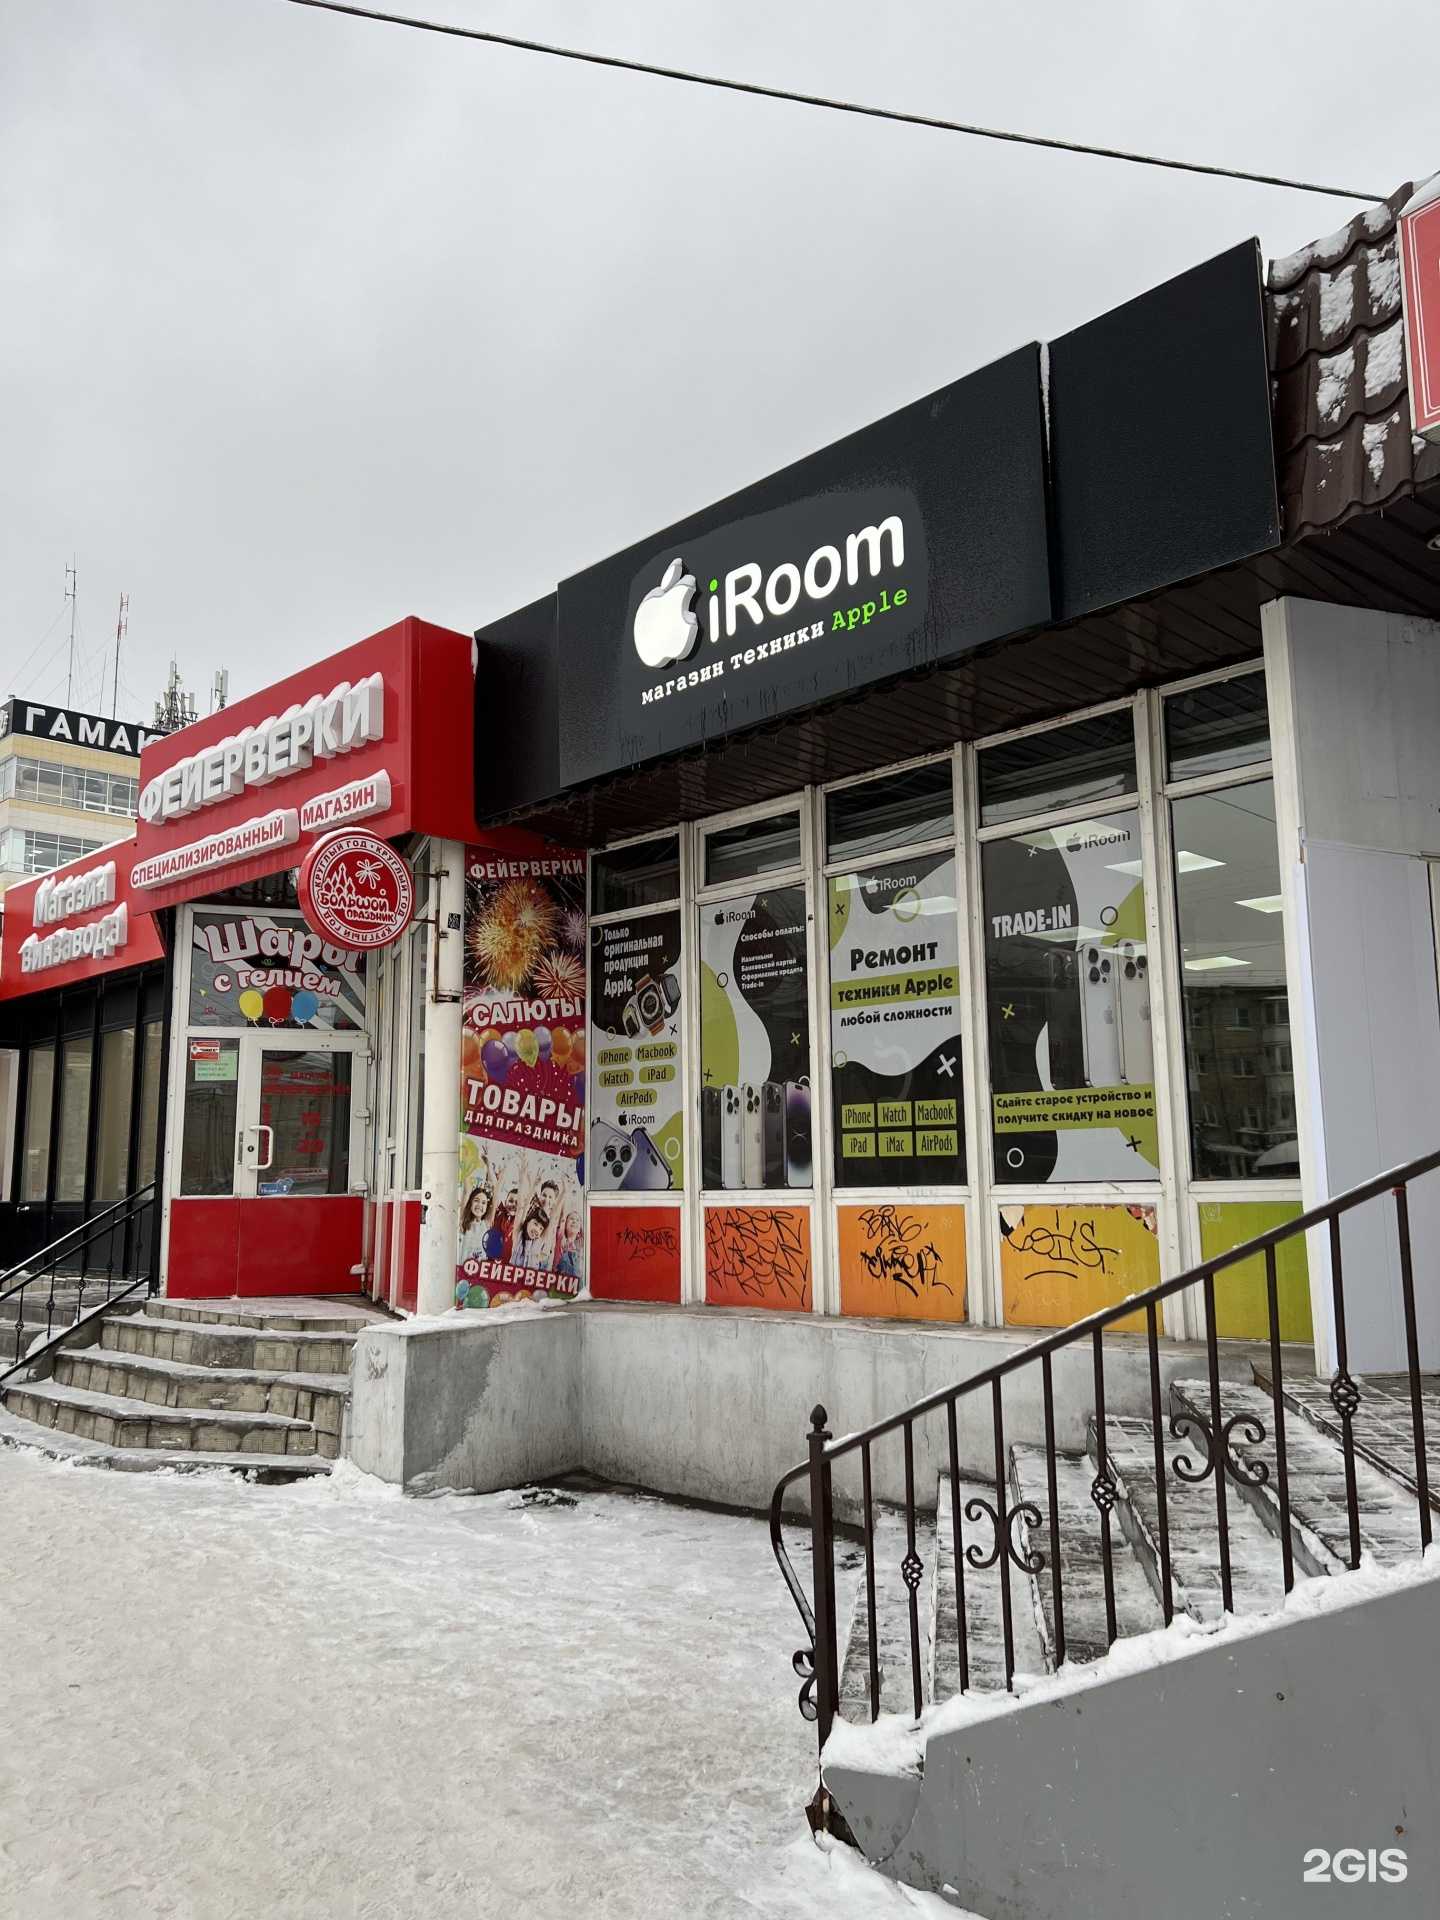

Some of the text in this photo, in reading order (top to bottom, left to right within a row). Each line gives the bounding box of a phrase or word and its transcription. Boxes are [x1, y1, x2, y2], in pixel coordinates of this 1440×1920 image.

[709, 516, 905, 643] iRoom
[641, 588, 909, 705] магазин техники Apple
[303, 784, 376, 827] МАГАЗИН
[131, 815, 284, 886] СПЕЦИАЛИЗИРОВАННЫЙ
[314, 840, 368, 888] КРУГЛЫЙ ГОД
[470, 859, 583, 879] ФЕЙЕРВЕРКИ
[375, 846, 409, 918] КРУГЛЫЙ ГОД
[323, 911, 341, 931] ГОД
[726, 909, 757, 923] iRoom
[992, 904, 1072, 938] TRADE-IN
[604, 927, 630, 941] Только
[740, 929, 774, 942] Способы
[603, 935, 664, 958] оригинальная
[850, 942, 938, 971] Ремонт
[604, 954, 649, 974] продукция
[213, 969, 342, 997] с гелием
[603, 975, 633, 998] Apple
[838, 974, 953, 1002] техники Apple
[472, 997, 582, 1027] САЛЮТЫ
[840, 1005, 952, 1027] любой сложности
[600, 1044, 674, 1065] iPhone Macbook
[603, 1067, 667, 1085] Watch iPad
[467, 1079, 582, 1131] ТОВАРЫ
[620, 1091, 653, 1105] AirPods
[996, 1090, 1152, 1109] Сдайте старое устройство и
[628, 1113, 655, 1125] iRoom
[845, 1104, 954, 1124] iPhone Watch Macbook
[997, 1107, 1154, 1125] получите скидку на новое
[463, 1110, 578, 1146] ДЛЯ ПРАЗДНИКА
[850, 1135, 953, 1153] iPad iMac AirPods
[463, 1259, 579, 1295] ФЕЙЕРВЕРКИ
